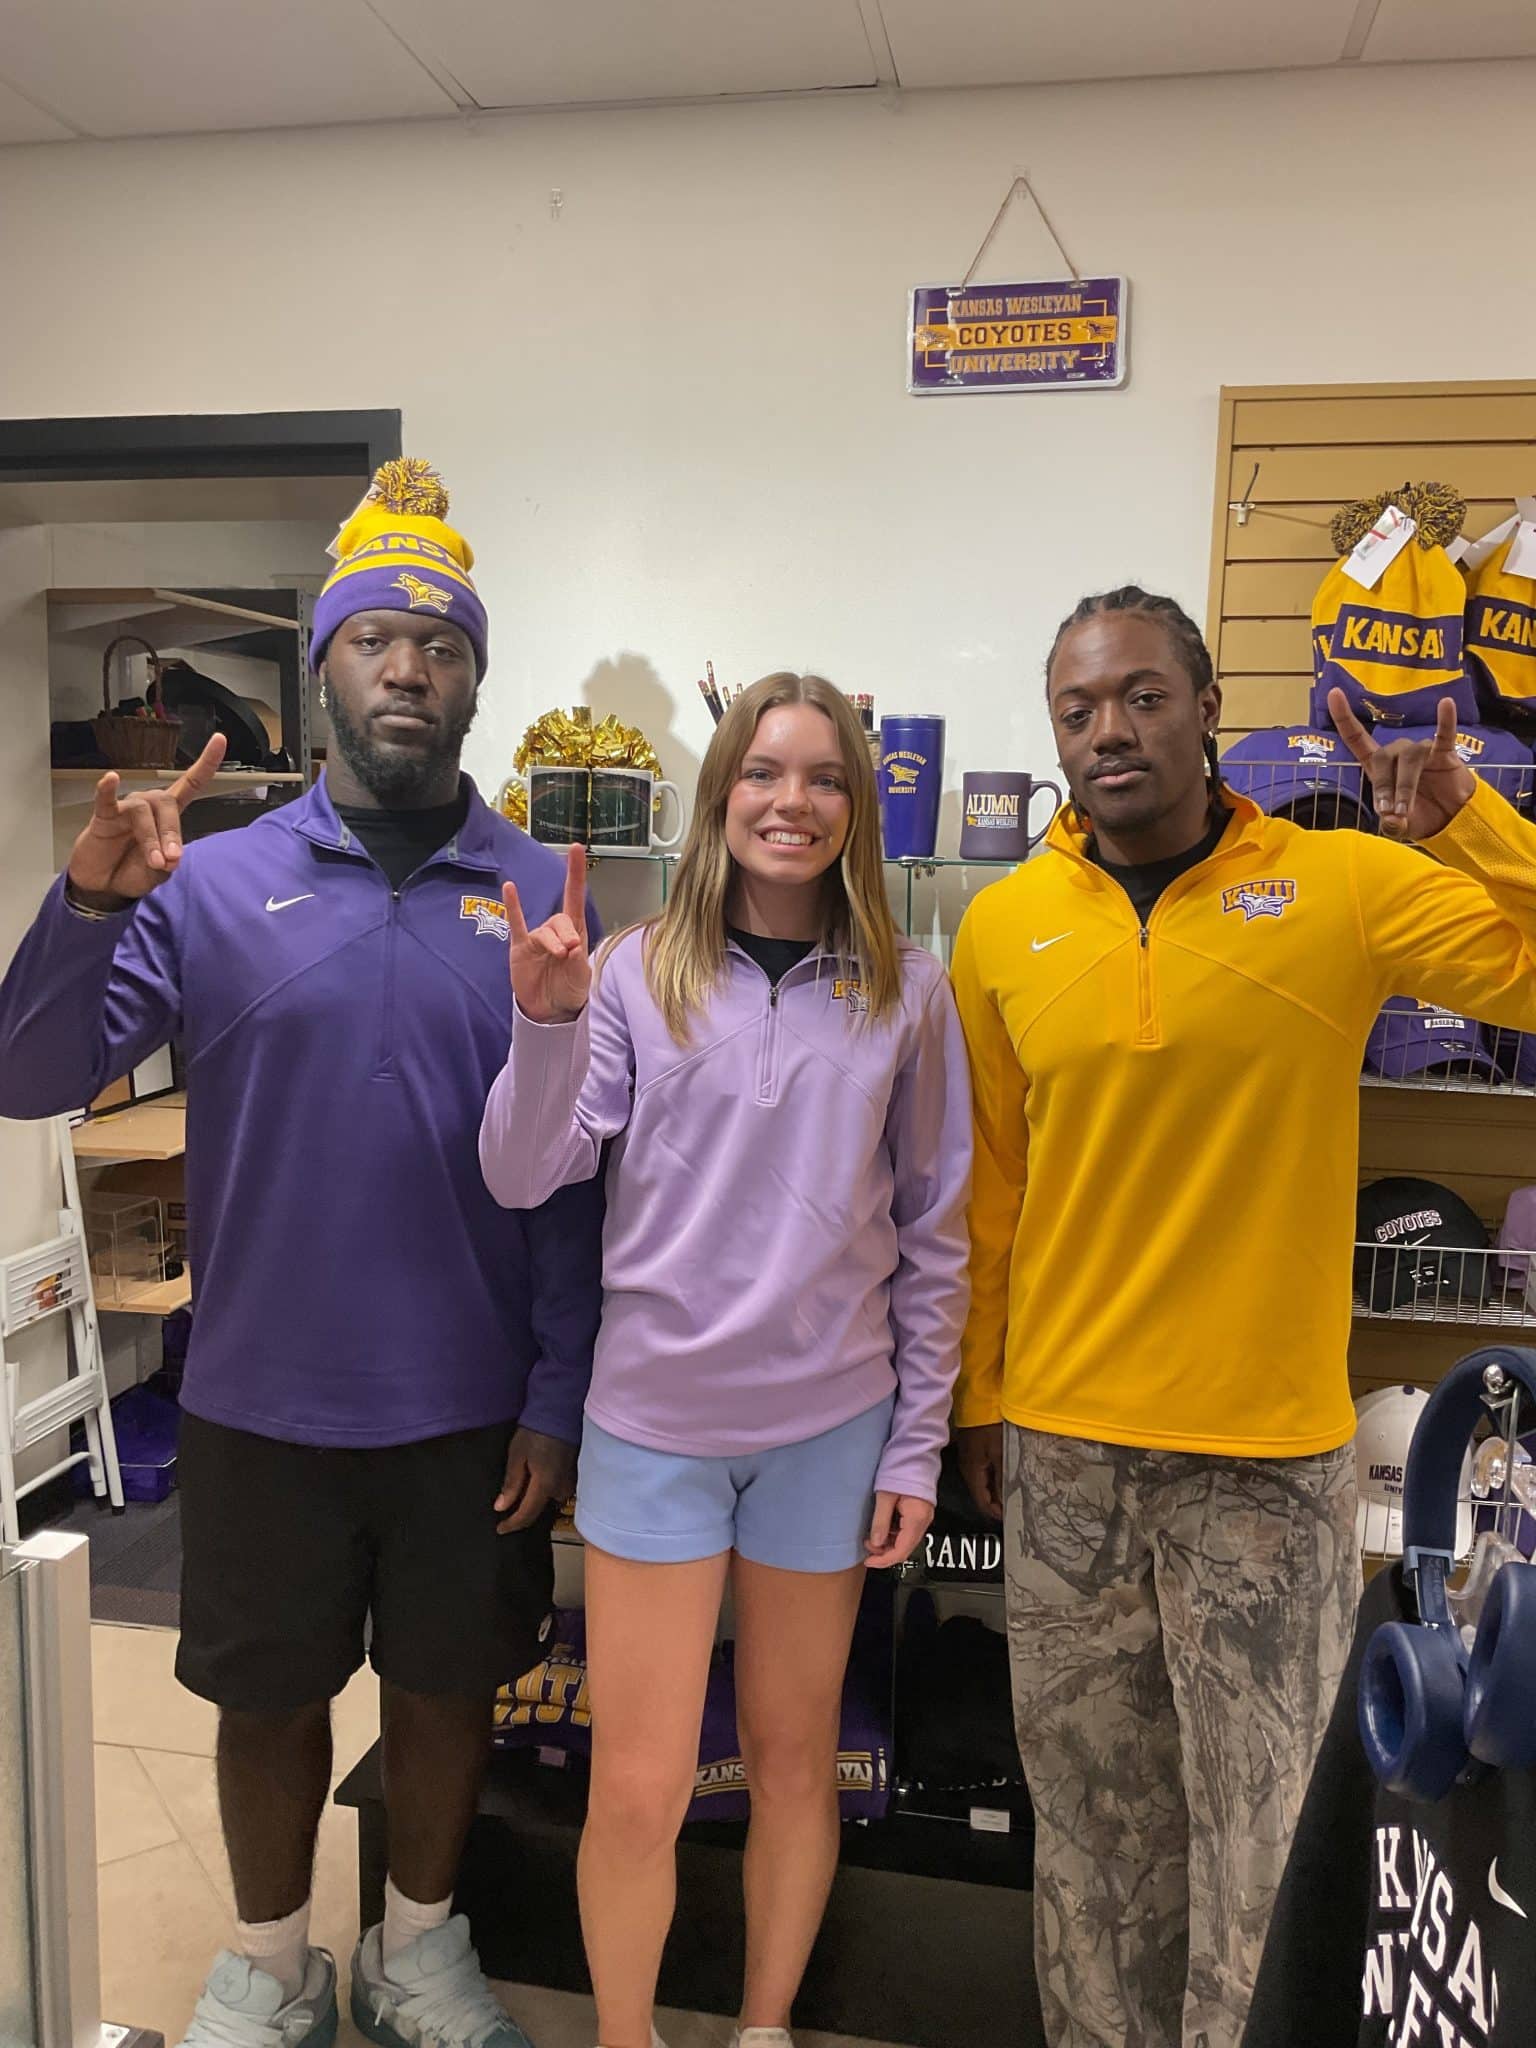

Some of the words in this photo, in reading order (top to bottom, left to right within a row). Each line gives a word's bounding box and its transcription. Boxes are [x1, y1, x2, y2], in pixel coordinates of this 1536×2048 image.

[950, 298, 1003, 318] KANSAS
[1006, 293, 1082, 316] WESLEYAN
[958, 322, 1072, 346] COYOTES
[950, 349, 1081, 373] UNIVERSITY
[1342, 616, 1445, 660] KANSA
[966, 793, 1020, 815] ALUMNI
[1224, 881, 1294, 911] KWU
[1375, 1209, 1442, 1243] COYOTES
[1368, 1464, 1403, 1483] KANSAS
